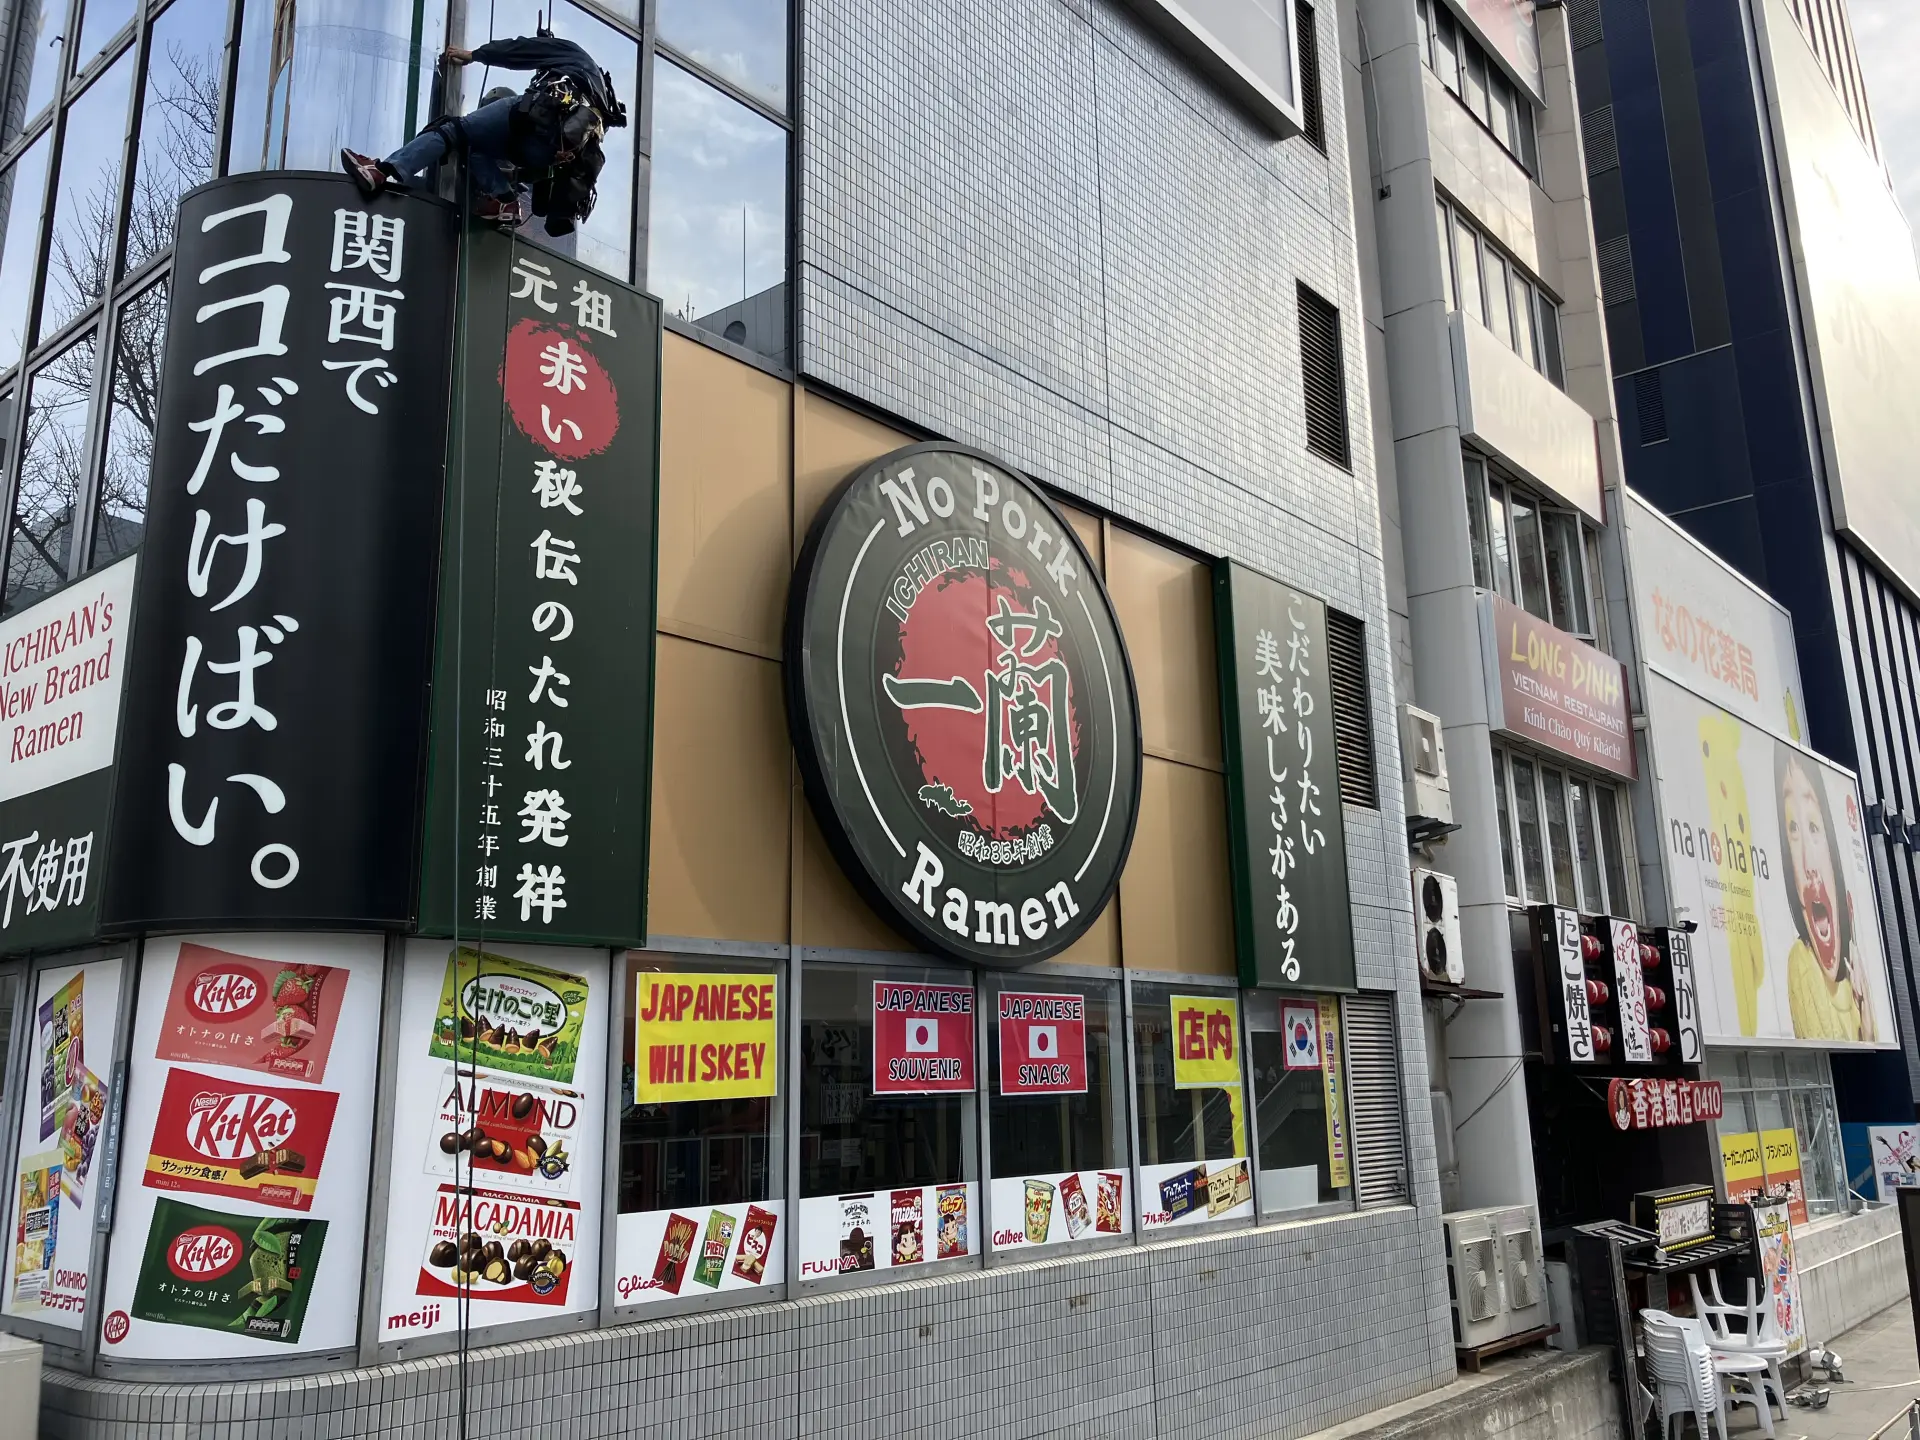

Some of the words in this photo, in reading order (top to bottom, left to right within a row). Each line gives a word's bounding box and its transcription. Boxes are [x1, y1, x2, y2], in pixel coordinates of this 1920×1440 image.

[321, 208, 405, 415] 関西で
[510, 258, 618, 338] 元祖
[168, 193, 300, 889] ココだけばい。
[879, 467, 955, 538] No
[971, 467, 1079, 597] Pork
[885, 537, 990, 622] ICHIRAN
[3, 592, 113, 677] ICHIRAN's
[512, 341, 588, 925] 赤い秘伝のたれ発祥
[1652, 586, 1758, 703] なの花薬局
[44, 638, 112, 705] Brand
[1511, 621, 1565, 684] LONG
[1570, 652, 1619, 709] DINH
[882, 595, 1078, 824] 一蘭
[1512, 670, 1559, 704] VIETNAM
[1564, 694, 1623, 733] RESTAURANT
[10, 711, 83, 763] Ramen
[1287, 593, 1326, 855] こだわりたい
[1524, 706, 1546, 731] Kính
[1548, 718, 1571, 741] Chào
[1574, 728, 1591, 752] Quý
[474, 688, 507, 921] 昭和三十五年創業
[1255, 629, 1300, 982] 美味しさがある
[958, 825, 1054, 865] 昭和35年創業
[0, 831, 94, 929] 不使用
[902, 841, 1080, 945] Ramen
[1704, 877, 1727, 893] Healthcare
[1730, 882, 1751, 899] Cosmetics
[1738, 924, 1757, 936] SHOP
[198, 976, 255, 1012] KitKat
[641, 984, 773, 1022] JAPANESE
[876, 989, 973, 1014] JAPANESE
[1557, 911, 1590, 1058] たこ焼き
[1671, 933, 1698, 1060] 串かつ
[466, 985, 561, 1028] たけのこの里
[1001, 998, 1083, 1021] JAPANESE
[1178, 1007, 1233, 1061] 店内
[649, 1043, 766, 1084] WHISKEY
[889, 1057, 961, 1081] SOUVENIR
[1018, 1064, 1070, 1085] SNACK
[507, 1079, 544, 1090] ALMOND
[1632, 1081, 1693, 1129] 香港飯店
[1693, 1085, 1721, 1117] 0410
[194, 1095, 293, 1158] KitKat
[1723, 1148, 1759, 1167] オーガニックコスメ
[1766, 1143, 1792, 1160] ブランドコスメ
[156, 1178, 169, 1186] mini
[483, 1191, 540, 1203] MACADAMIA
[1164, 1178, 1191, 1198] アルフォート
[1208, 1174, 1234, 1192] アルフォート
[435, 1196, 575, 1241] MACADAMIA
[842, 1219, 871, 1229] チョコまみれ
[892, 1207, 923, 1229] Milky
[941, 1197, 963, 1214] ポップ
[1143, 1210, 1173, 1225] ブルボン
[178, 1236, 232, 1271] KitKat
[705, 1242, 725, 1259] PRETZ
[747, 1234, 763, 1254] ビスコ
[993, 1230, 1023, 1247] Calbee
[56, 1269, 87, 1290] ORIHIRO
[802, 1255, 860, 1275] FUJIYA
[40, 1290, 85, 1313] マンナンライフ
[618, 1275, 663, 1299] Glico
[106, 1317, 127, 1338] KitKat
[388, 1304, 440, 1329] meiji
